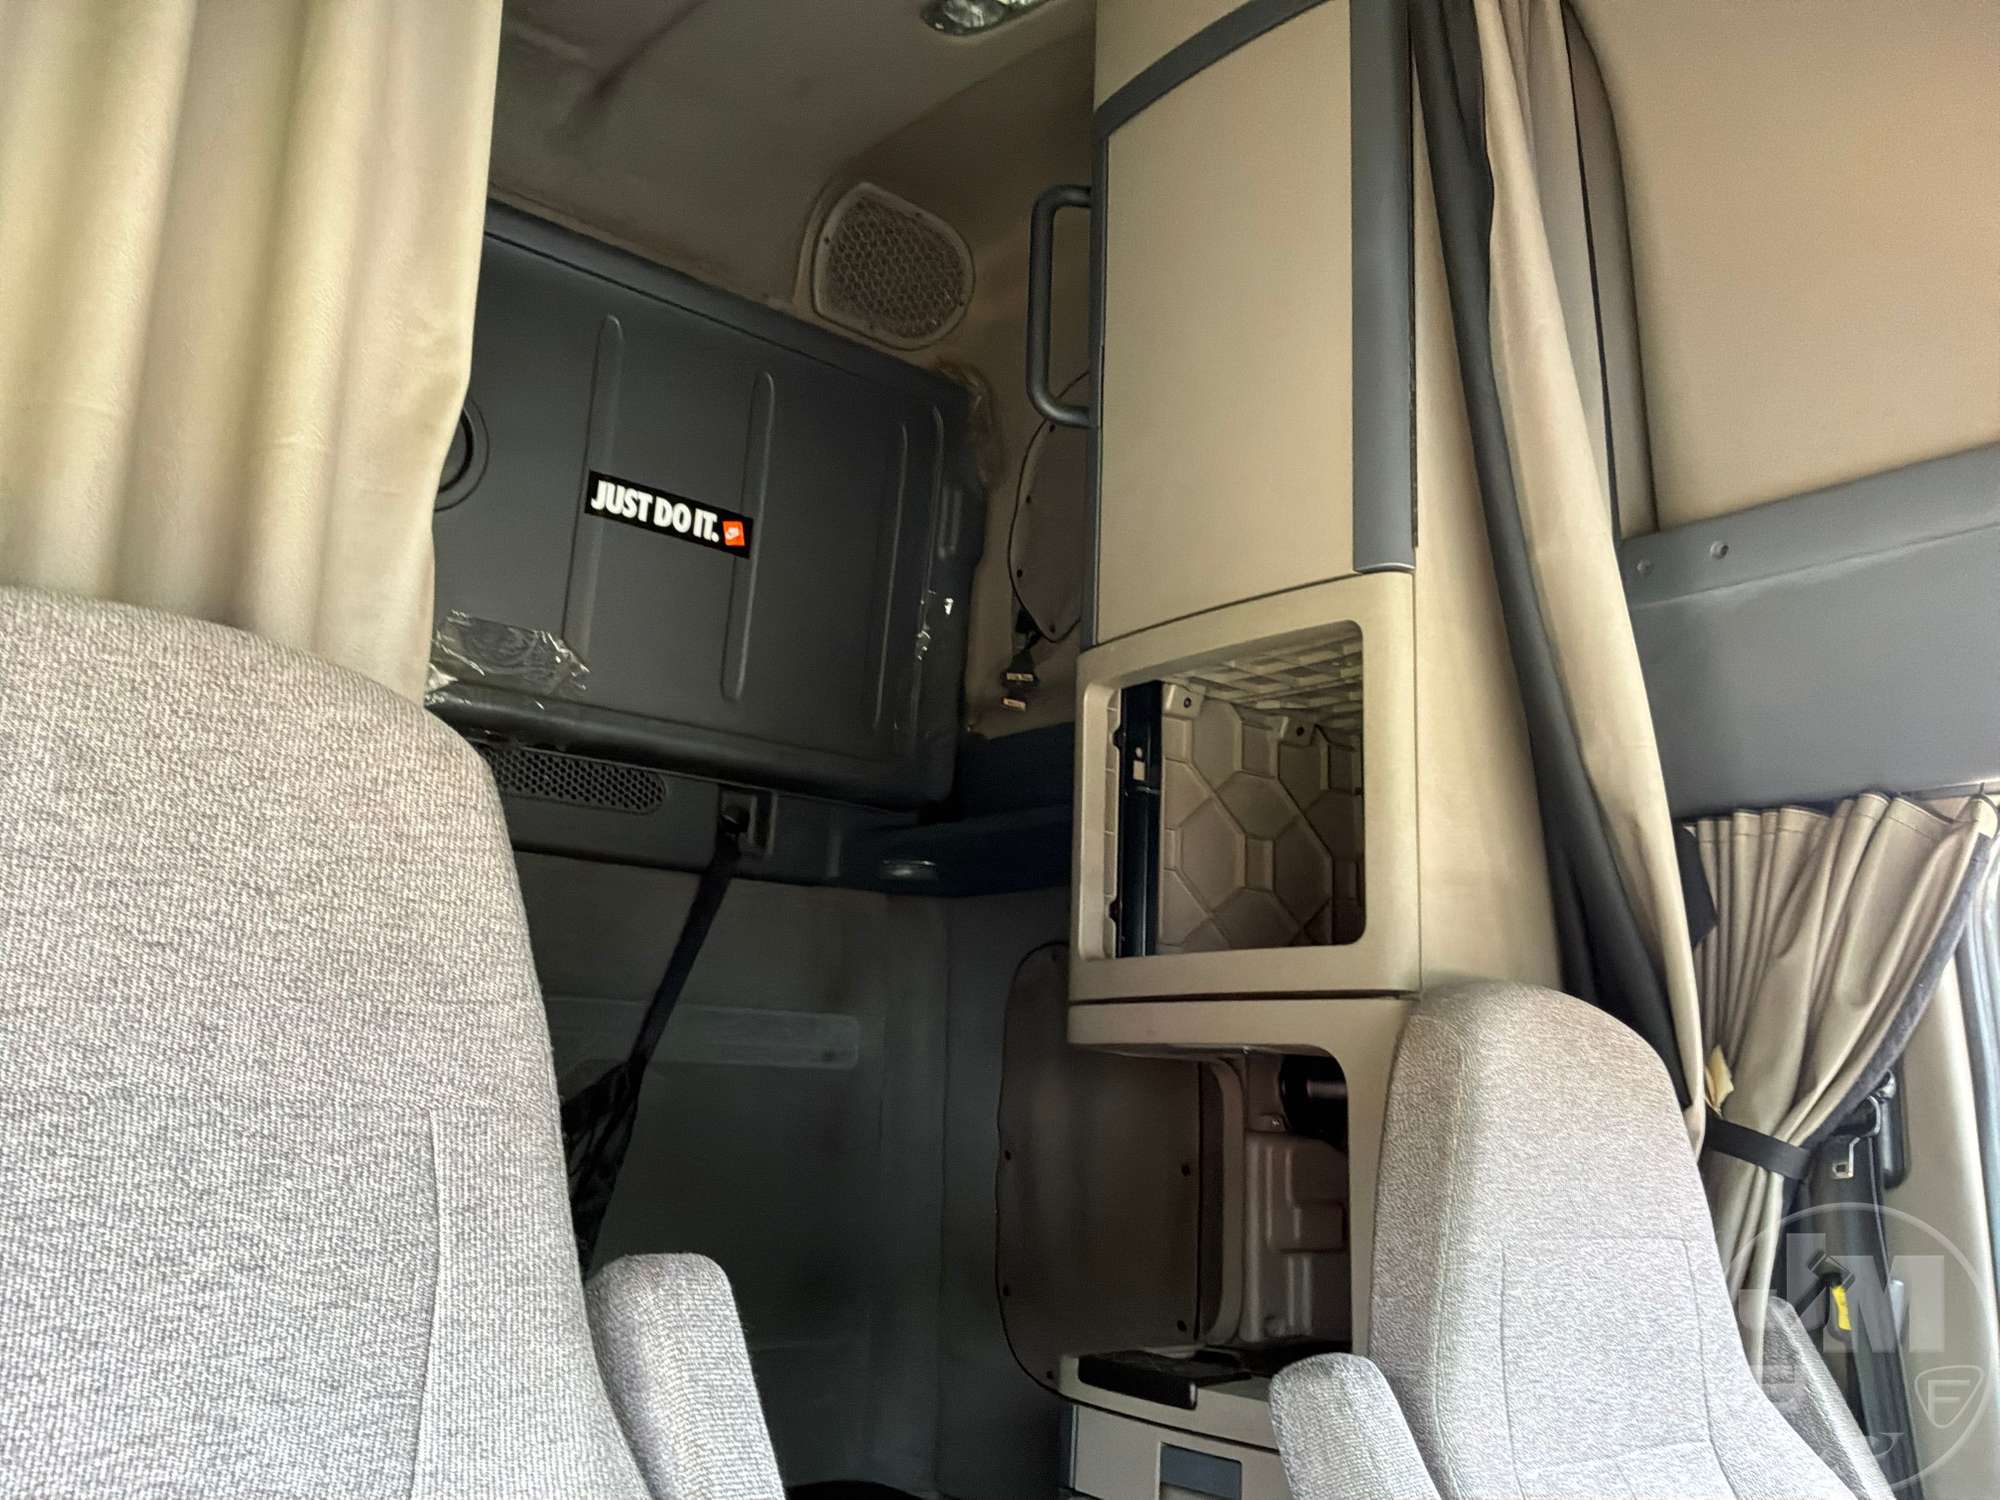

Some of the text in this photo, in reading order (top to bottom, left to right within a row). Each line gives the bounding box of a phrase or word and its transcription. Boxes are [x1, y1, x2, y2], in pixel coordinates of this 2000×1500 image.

[591, 479, 720, 543] JUST DO IT.
